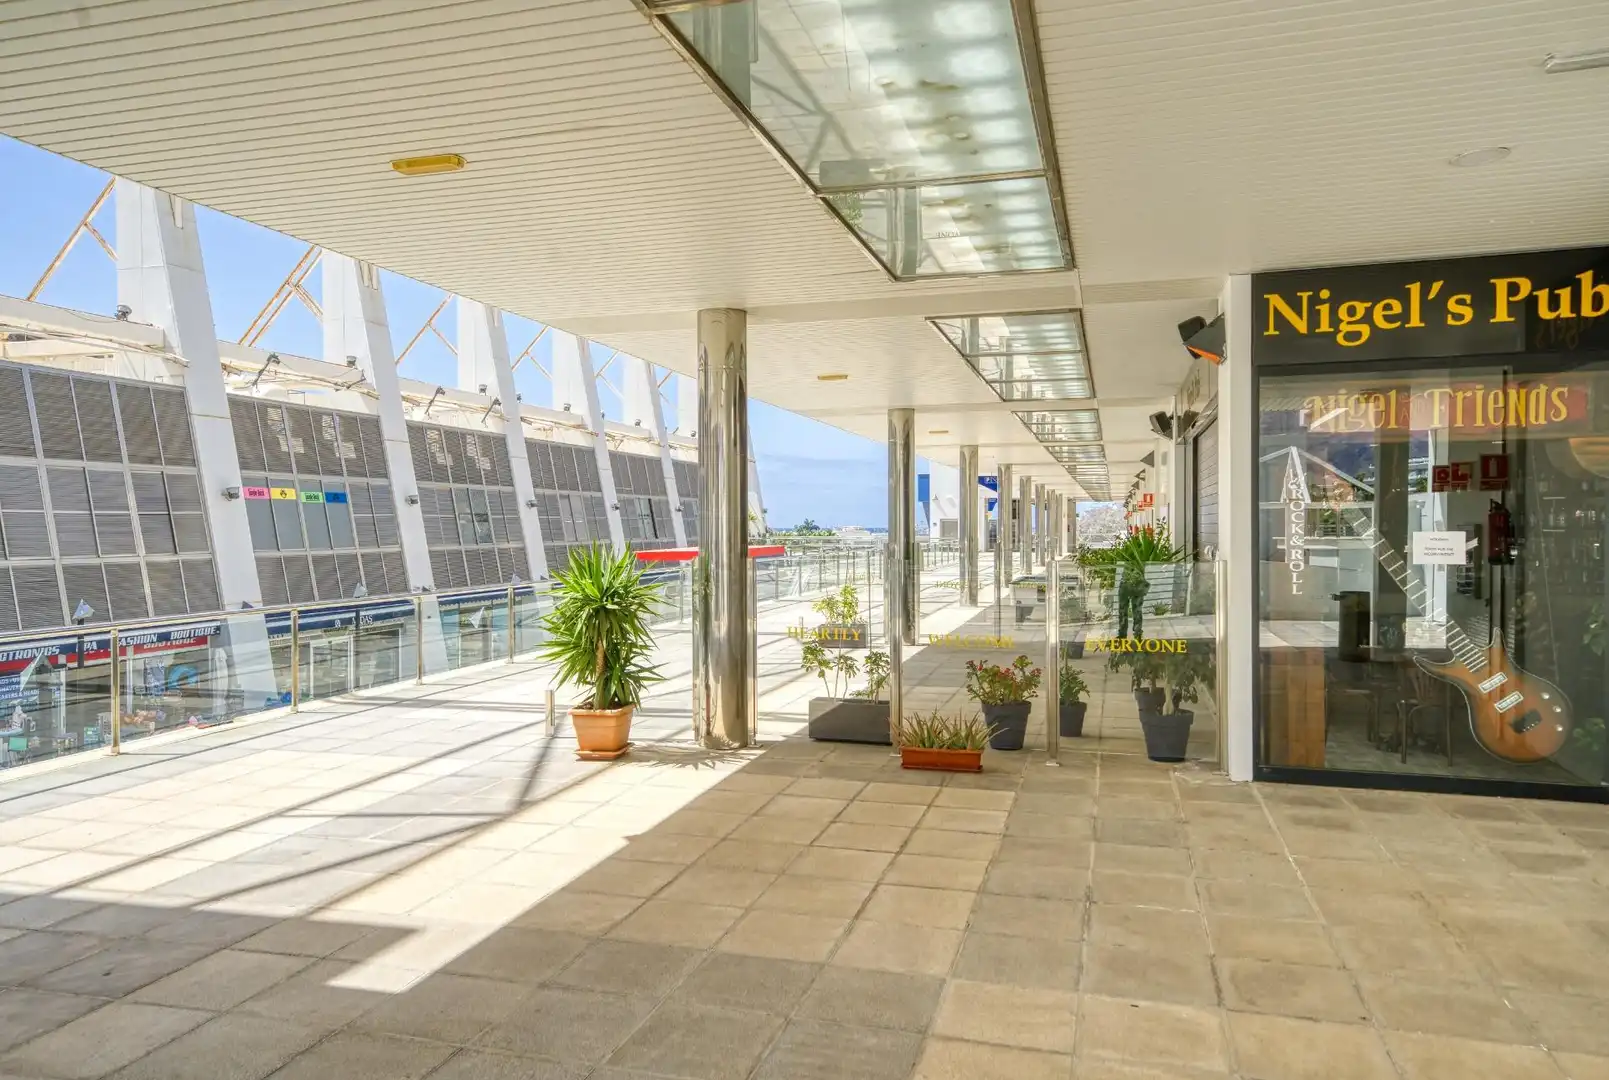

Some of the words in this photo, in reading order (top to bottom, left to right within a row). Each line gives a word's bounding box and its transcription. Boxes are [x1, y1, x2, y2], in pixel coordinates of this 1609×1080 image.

[1263, 280, 1474, 348] Nigel's
[1489, 269, 1609, 324] Pub
[1084, 637, 1188, 654] EVERYONE
